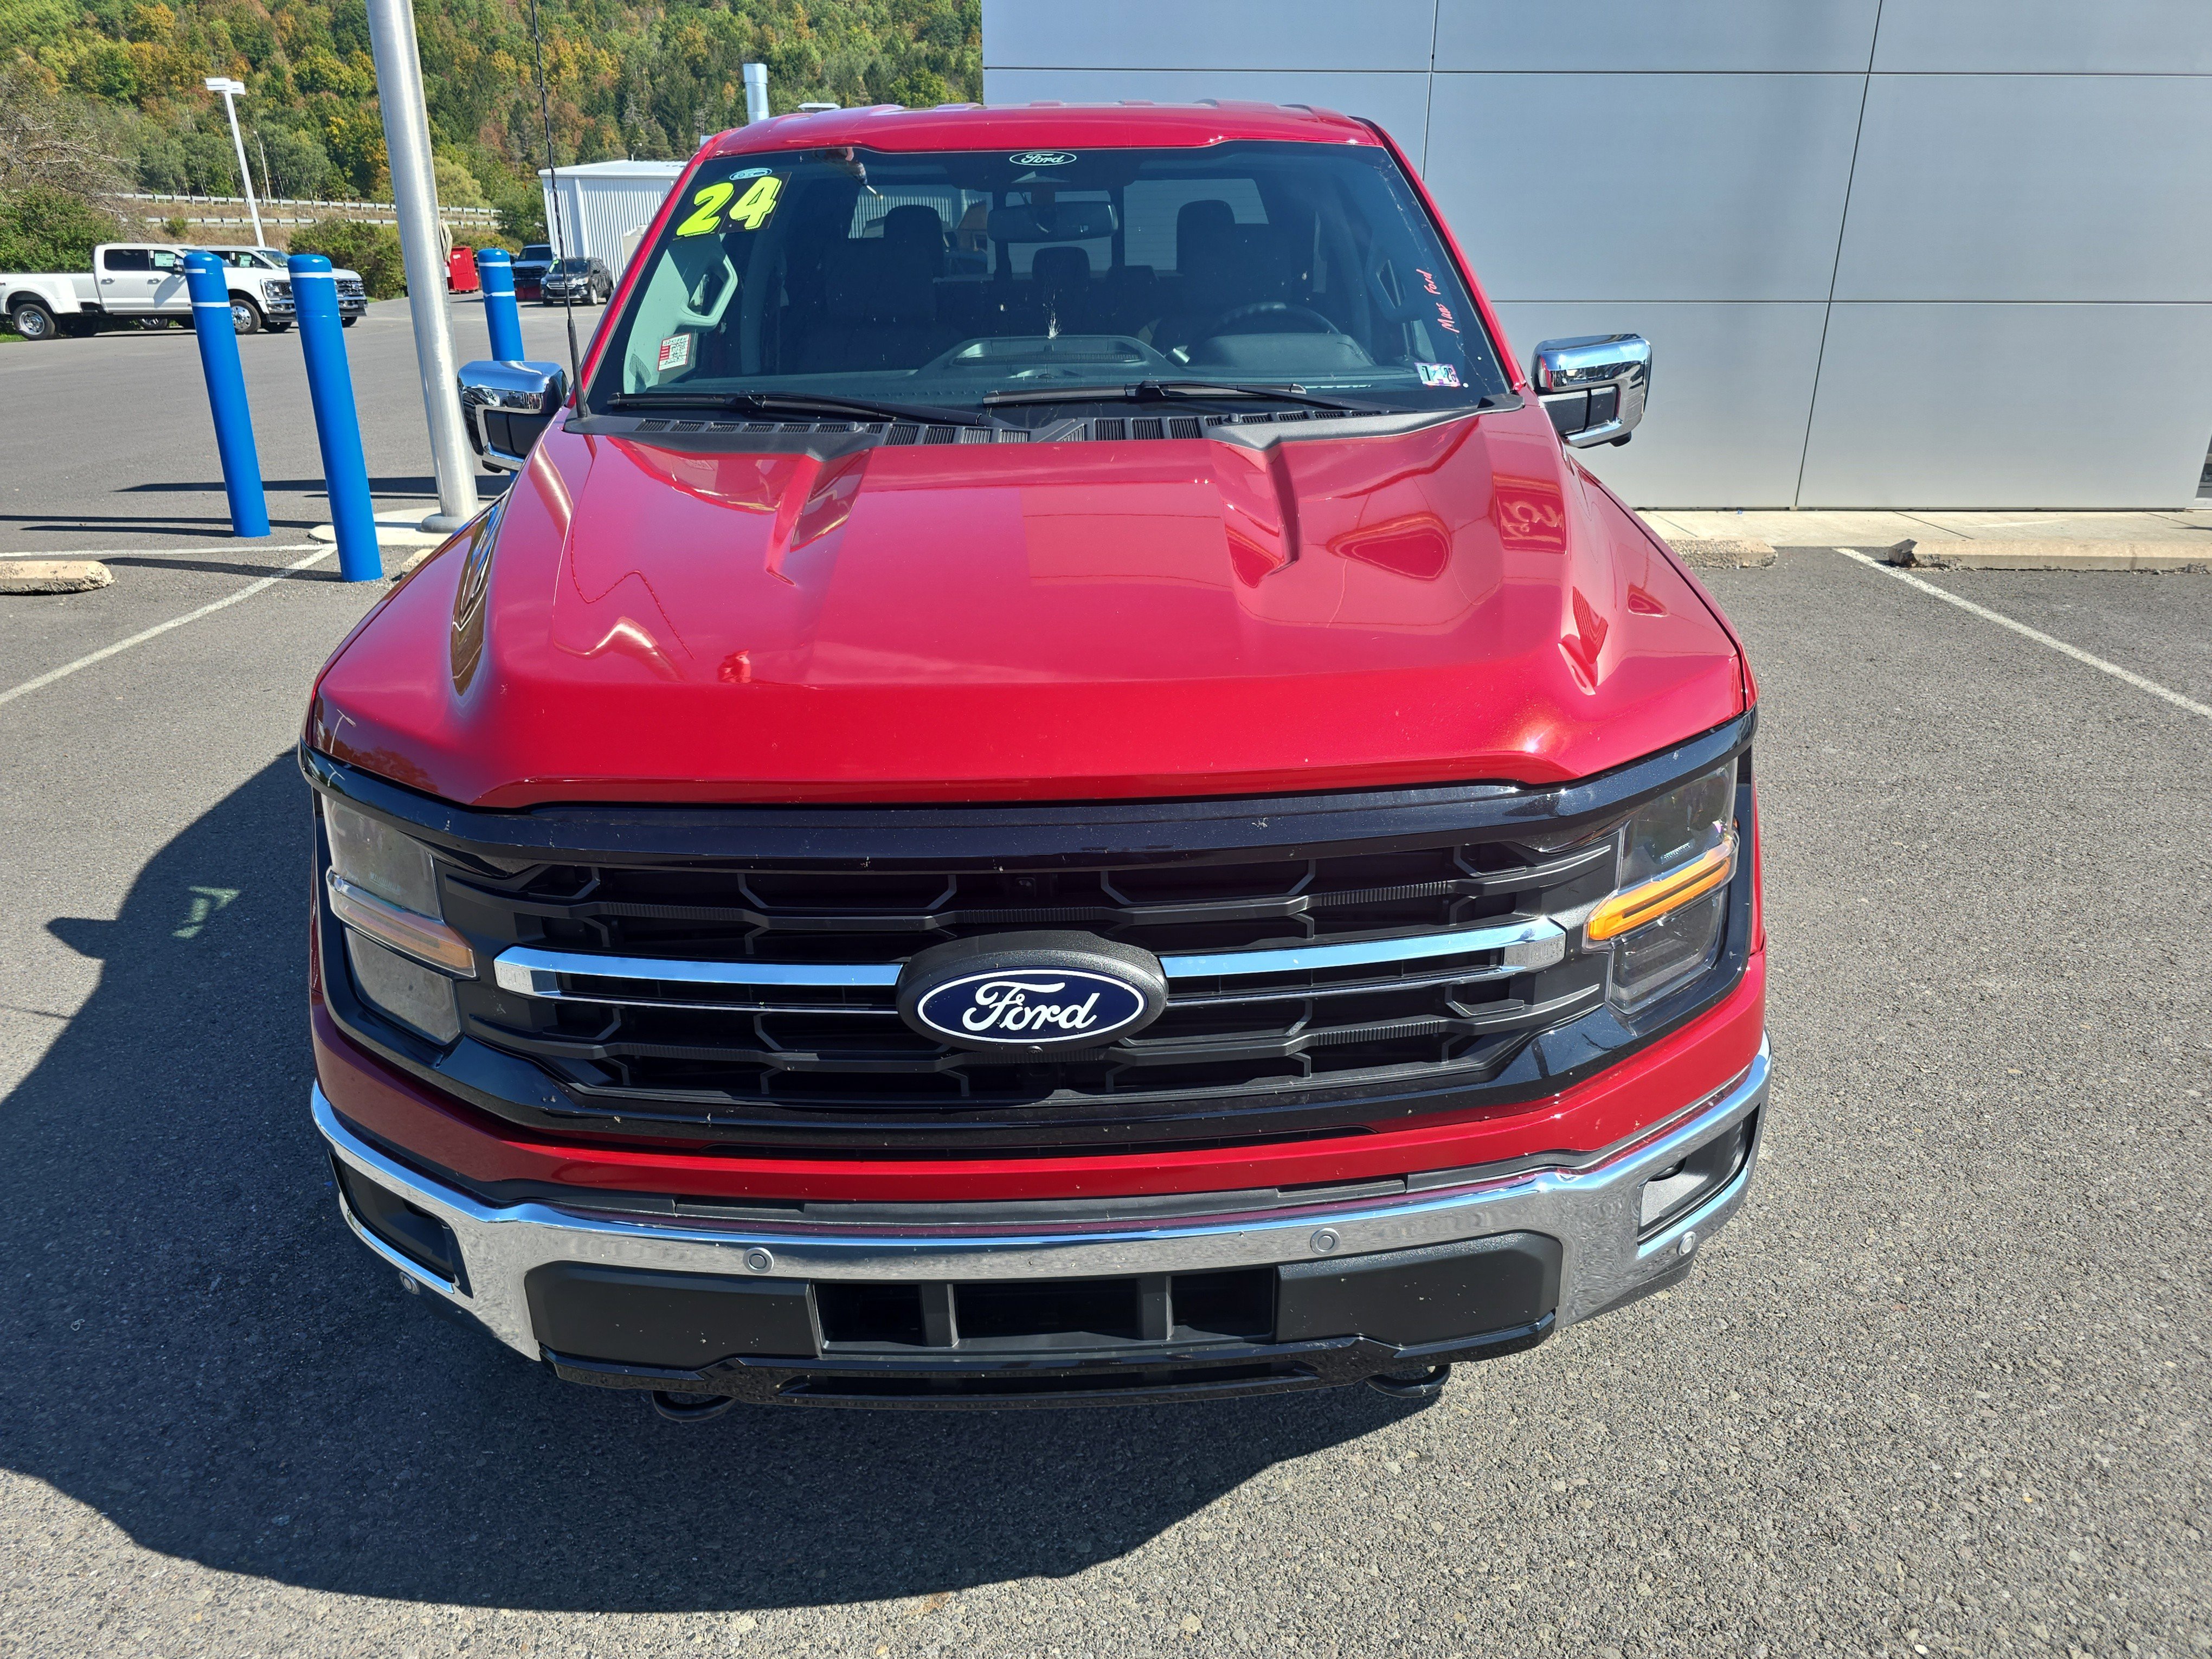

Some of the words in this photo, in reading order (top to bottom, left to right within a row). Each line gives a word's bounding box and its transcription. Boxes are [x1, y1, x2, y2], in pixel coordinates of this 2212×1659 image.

[1021, 153, 1065, 164] Ford
[676, 176, 782, 237] 24
[1416, 268, 1441, 294] Ford
[962, 981, 1101, 1031] Ford
